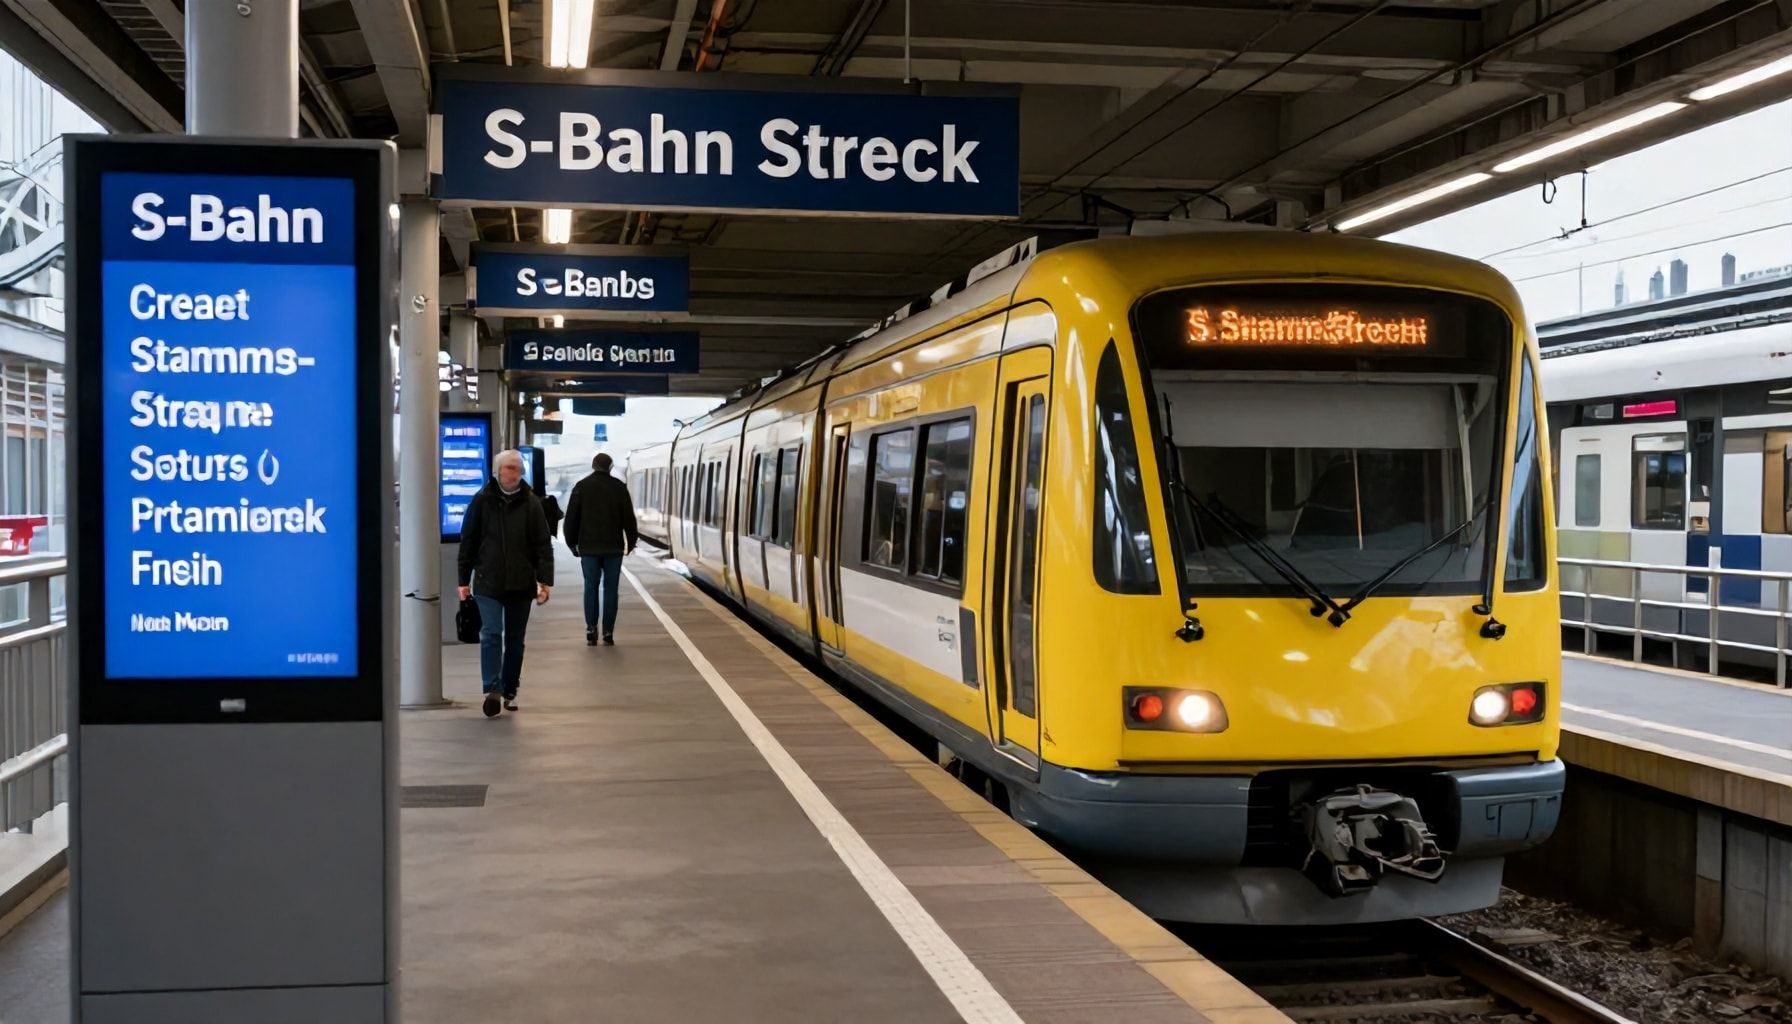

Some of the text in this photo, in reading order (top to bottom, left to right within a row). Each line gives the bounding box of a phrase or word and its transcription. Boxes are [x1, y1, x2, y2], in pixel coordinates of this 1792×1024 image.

[484, 108, 980, 184] S-Bahn Streck
[131, 192, 324, 243] S-Bahn
